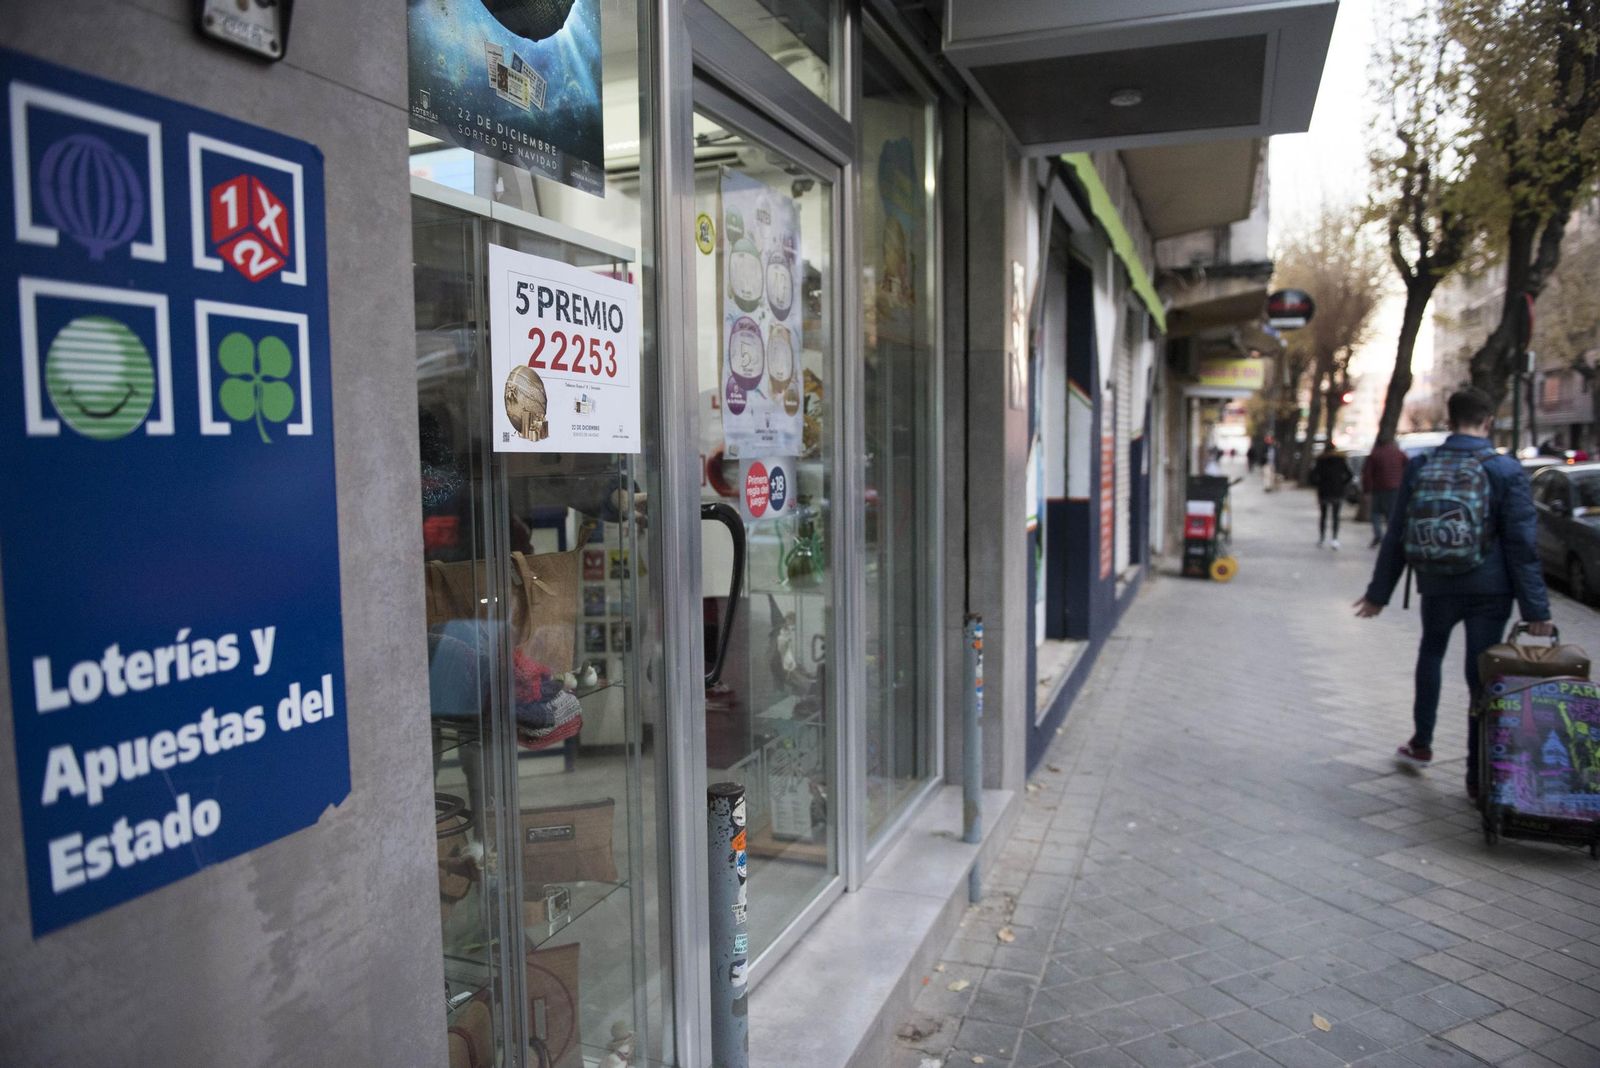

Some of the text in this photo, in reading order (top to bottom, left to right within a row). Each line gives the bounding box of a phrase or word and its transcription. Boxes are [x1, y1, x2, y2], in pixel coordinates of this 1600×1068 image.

[457, 124, 557, 170] SORTEO DE NAVIDAD
[458, 107, 471, 121] 22
[477, 114, 491, 131] DE
[497, 123, 557, 156] DICIEMBRE
[515, 280, 624, 333] 5º PREMIO
[527, 327, 617, 378] 22253
[770, 475, 784, 491] +18
[32, 625, 277, 714] Loterías y
[1559, 683, 1600, 699] PARI
[1488, 699, 1522, 712] ARIS
[41, 673, 334, 807] Apuestas del
[47, 793, 222, 895] Estado
